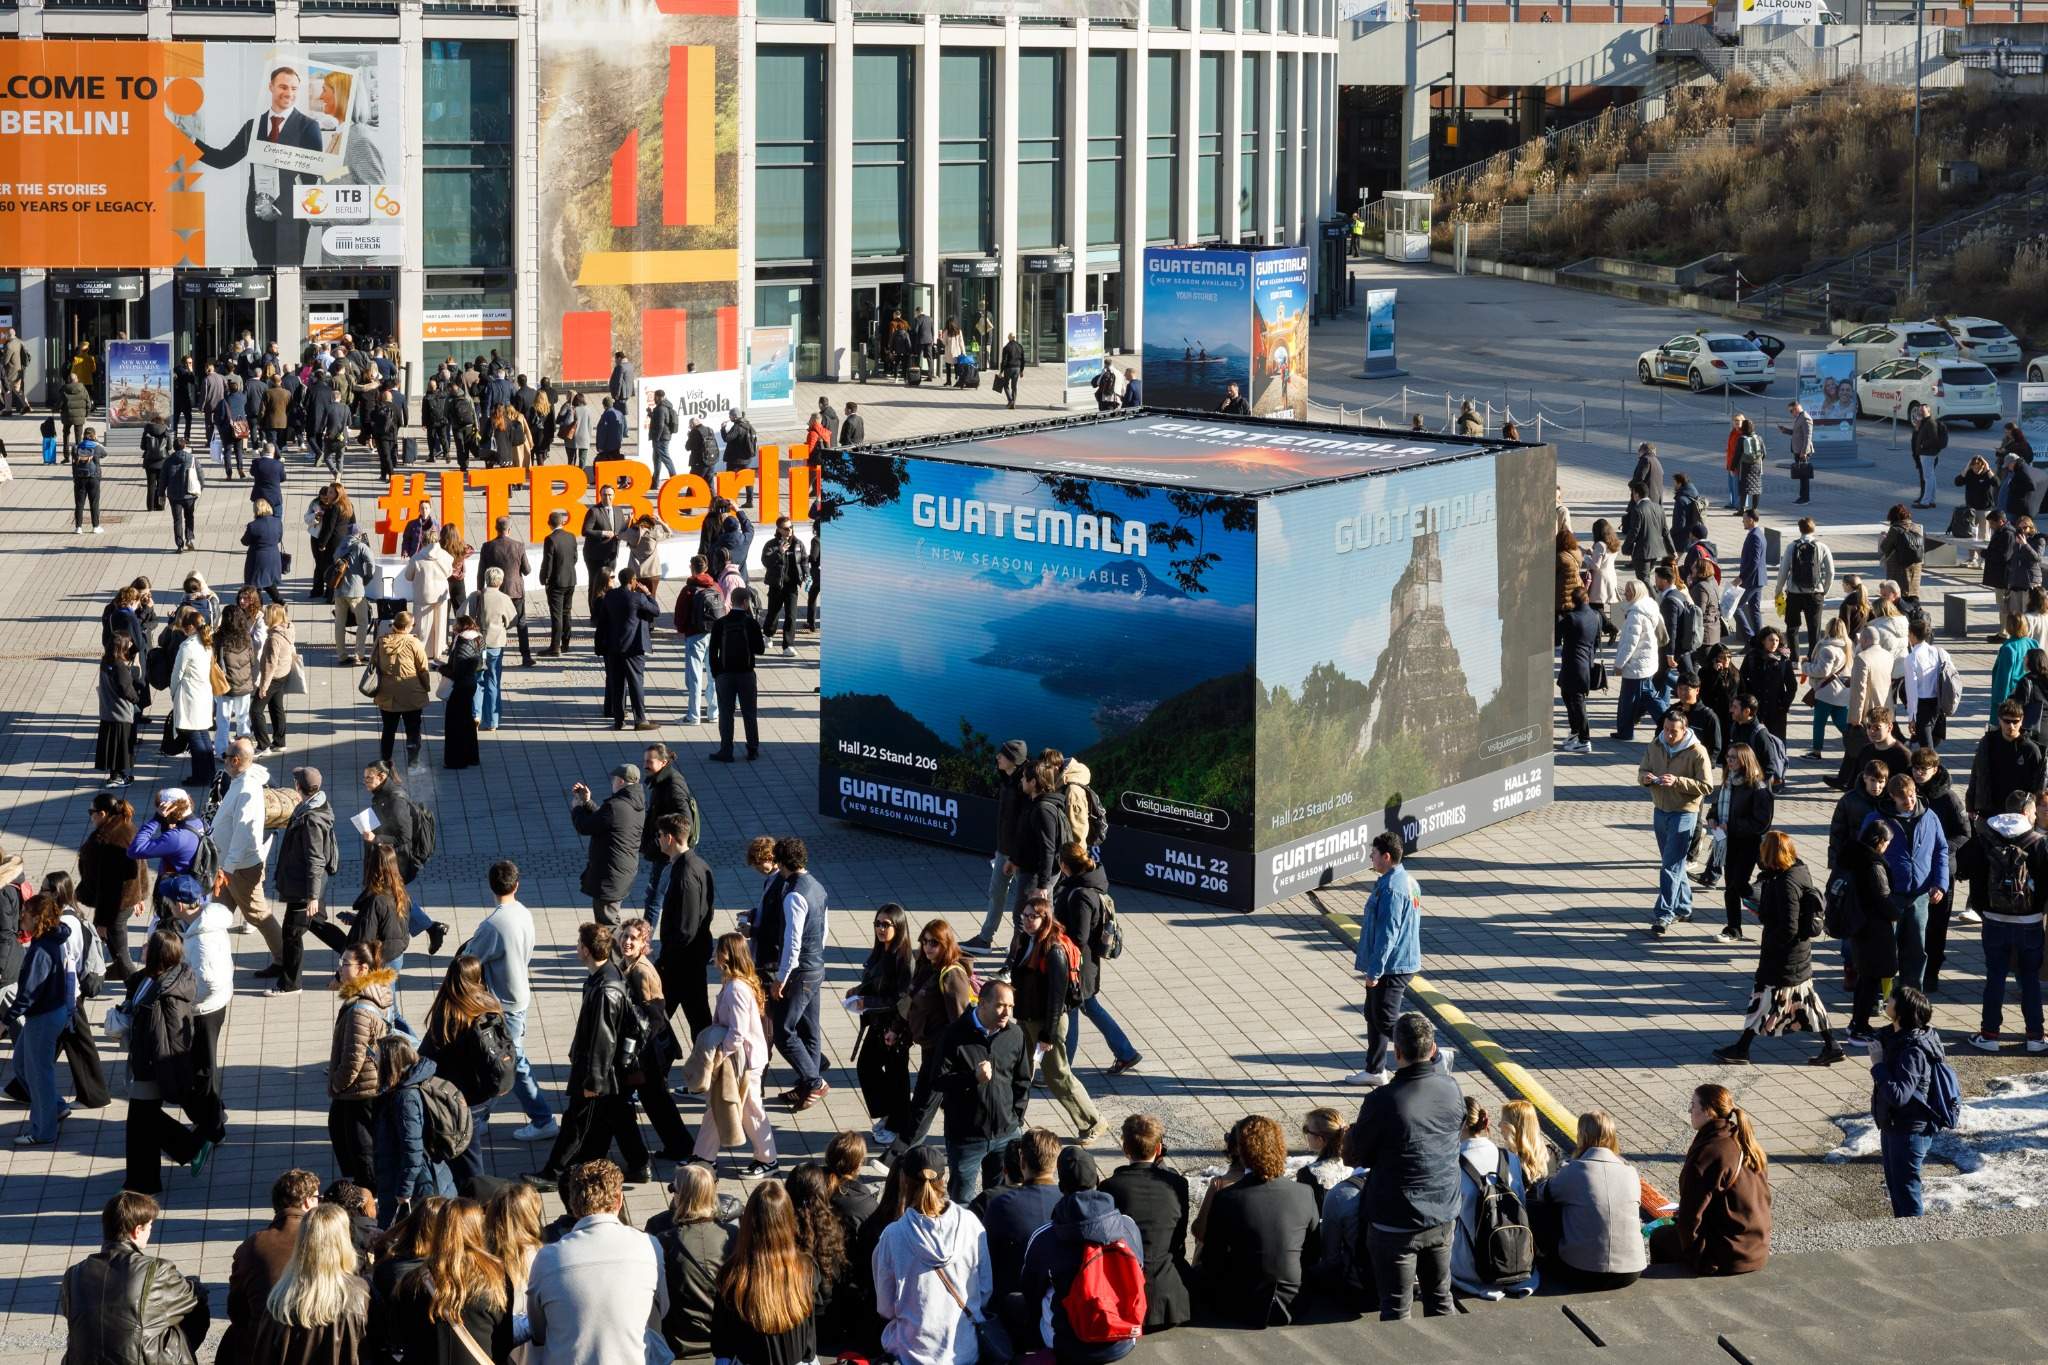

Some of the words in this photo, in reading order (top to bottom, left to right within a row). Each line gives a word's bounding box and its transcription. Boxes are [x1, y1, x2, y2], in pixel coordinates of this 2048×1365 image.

[1756, 0, 1812, 9] ALLROUND
[0, 75, 105, 99] COME
[116, 76, 158, 100] TO
[0, 110, 129, 135] BERLIN!
[16, 184, 43, 195] THE
[48, 184, 107, 196] STORIES
[335, 189, 362, 203] ITB
[20, 201, 68, 212] YEARS
[72, 201, 91, 212] OF
[96, 201, 156, 213] LEGACY.
[335, 206, 362, 214] BERLIN
[1149, 259, 1246, 277] GUATEMALA
[1256, 257, 1307, 276] GUATEMALA
[1174, 278, 1200, 286] SEASON
[677, 393, 730, 420] Angola
[686, 389, 704, 400] Visit
[1148, 423, 1437, 455] GUATEMALA
[377, 443, 821, 555] #ITBBerli
[912, 492, 1147, 557] GUATEMALA
[1335, 488, 1497, 555] GUATEMALA
[932, 547, 965, 563] NEW
[972, 552, 1033, 573] SEASON
[1041, 562, 1129, 587] AVAILABLE
[838, 739, 860, 755] Hall
[862, 745, 877, 759] 22
[879, 748, 913, 766] Stand
[915, 755, 938, 770] 206
[1504, 772, 1529, 792] HALL
[1530, 768, 1542, 782] 22
[839, 776, 958, 819] GUATEMALA
[1136, 797, 1214, 824] visitguatemala.gt
[1271, 810, 1291, 829] Hall
[1292, 807, 1305, 821] 22
[1307, 795, 1334, 817] Stand
[1335, 791, 1353, 808] 206
[1424, 803, 1437, 813] ONLY
[1492, 790, 1524, 813] STAND
[1525, 784, 1542, 801] 206
[849, 801, 867, 812] NEW
[870, 806, 901, 819] SEASON
[904, 814, 948, 830] AVAILABLE
[1402, 817, 1427, 844] YOUR
[1428, 805, 1466, 832] STORIES
[1165, 848, 1206, 870] HALL
[1209, 858, 1229, 875] 22
[1272, 824, 1368, 876] GUATEMALA
[1144, 862, 1196, 886] STAND
[1200, 874, 1229, 893] 206
[1280, 874, 1295, 887] NEW
[1297, 865, 1323, 881] SEASON
[1324, 851, 1360, 870] AVAILABLE
